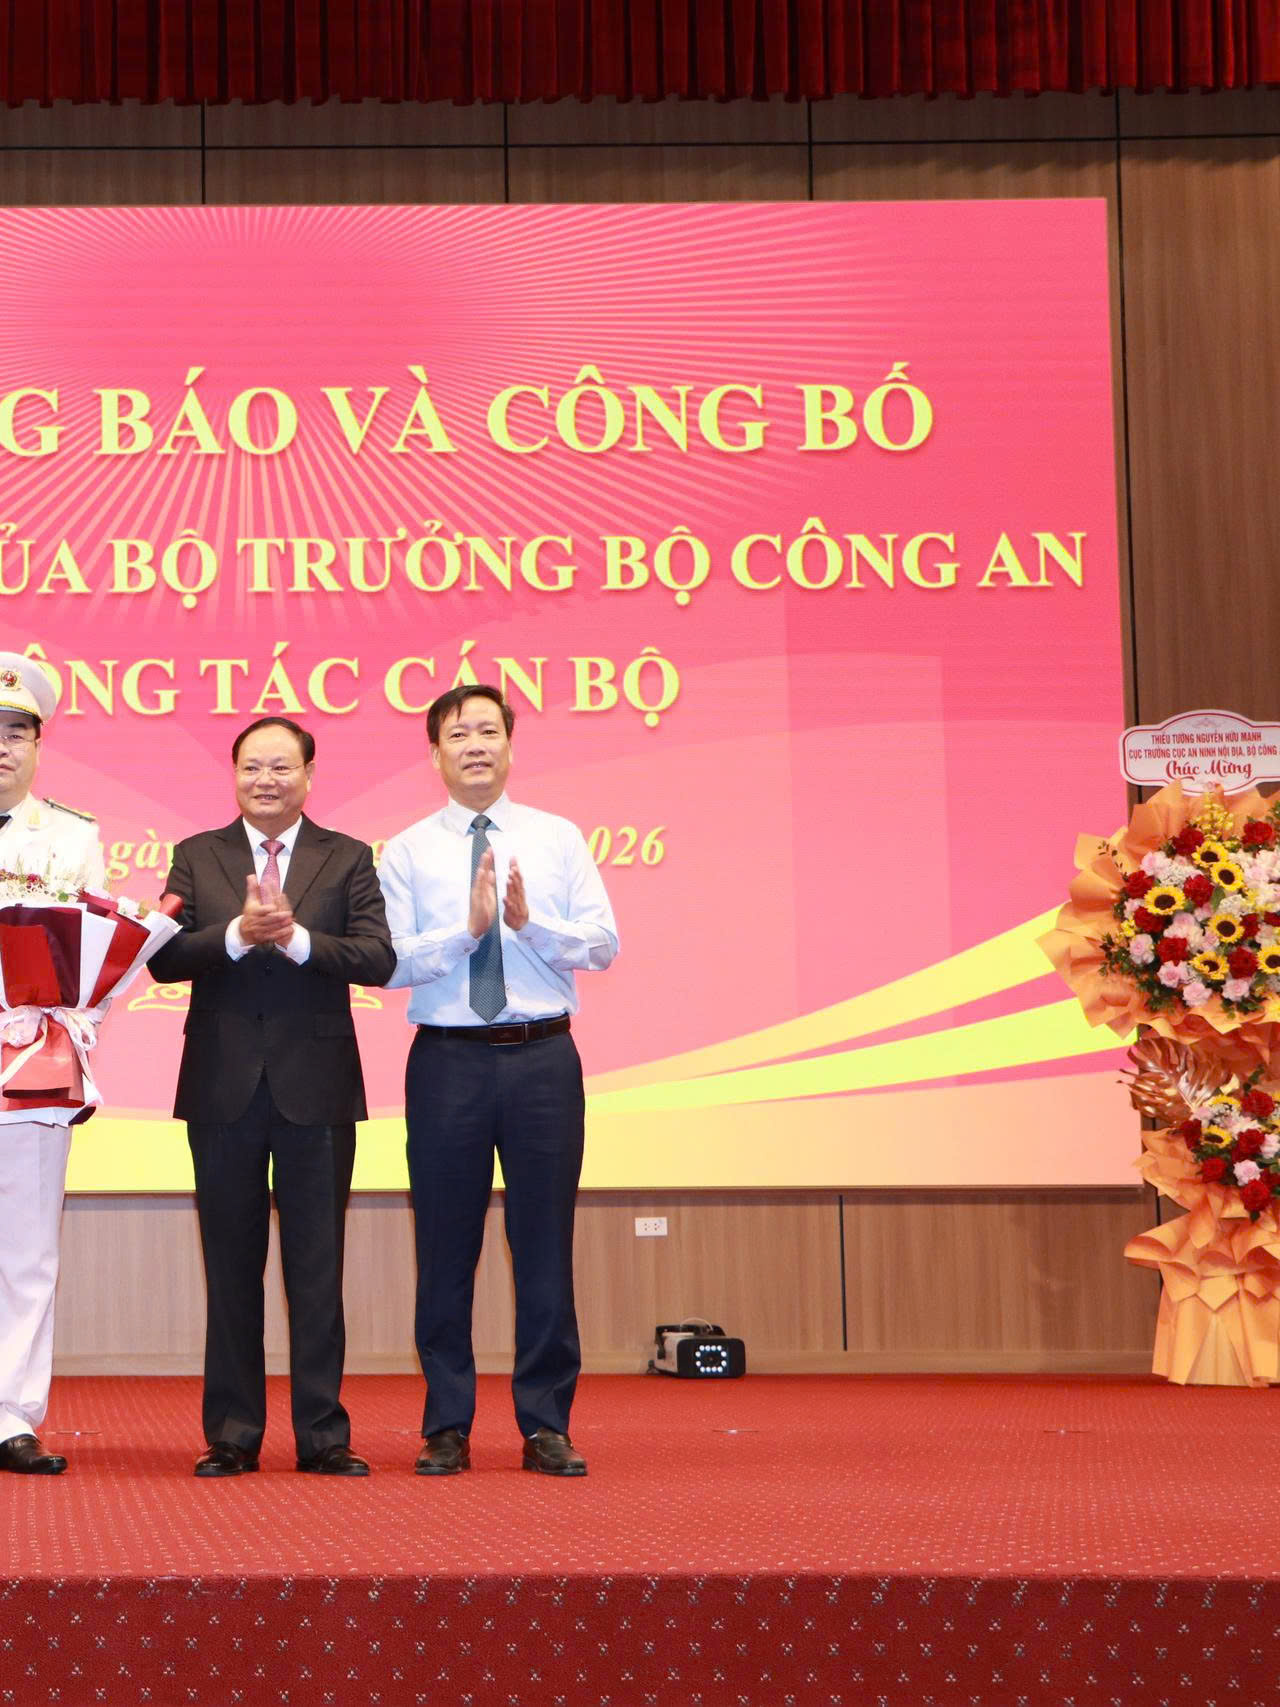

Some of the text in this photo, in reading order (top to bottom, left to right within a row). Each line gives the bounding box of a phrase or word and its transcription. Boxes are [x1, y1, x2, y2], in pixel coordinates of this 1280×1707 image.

[93, 366, 300, 456] BÁO
[320, 365, 458, 454] VÀ
[486, 364, 770, 454] CÔNG
[796, 361, 934, 452] BỐ
[107, 528, 218, 609] BỘ
[236, 519, 579, 593] TRƯỞNG
[600, 525, 711, 606] BỘ
[730, 517, 961, 590] CÔNG
[976, 531, 1087, 588] AN
[199, 641, 360, 715] TÁC
[383, 640, 549, 714] CÁN
[568, 646, 681, 727] BỘ
[1166, 760, 1252, 781] Chúc Mừng
[1187, 748, 1198, 758] AN
[1199, 747, 1217, 758] NINH
[99, 826, 667, 880] gày 026
